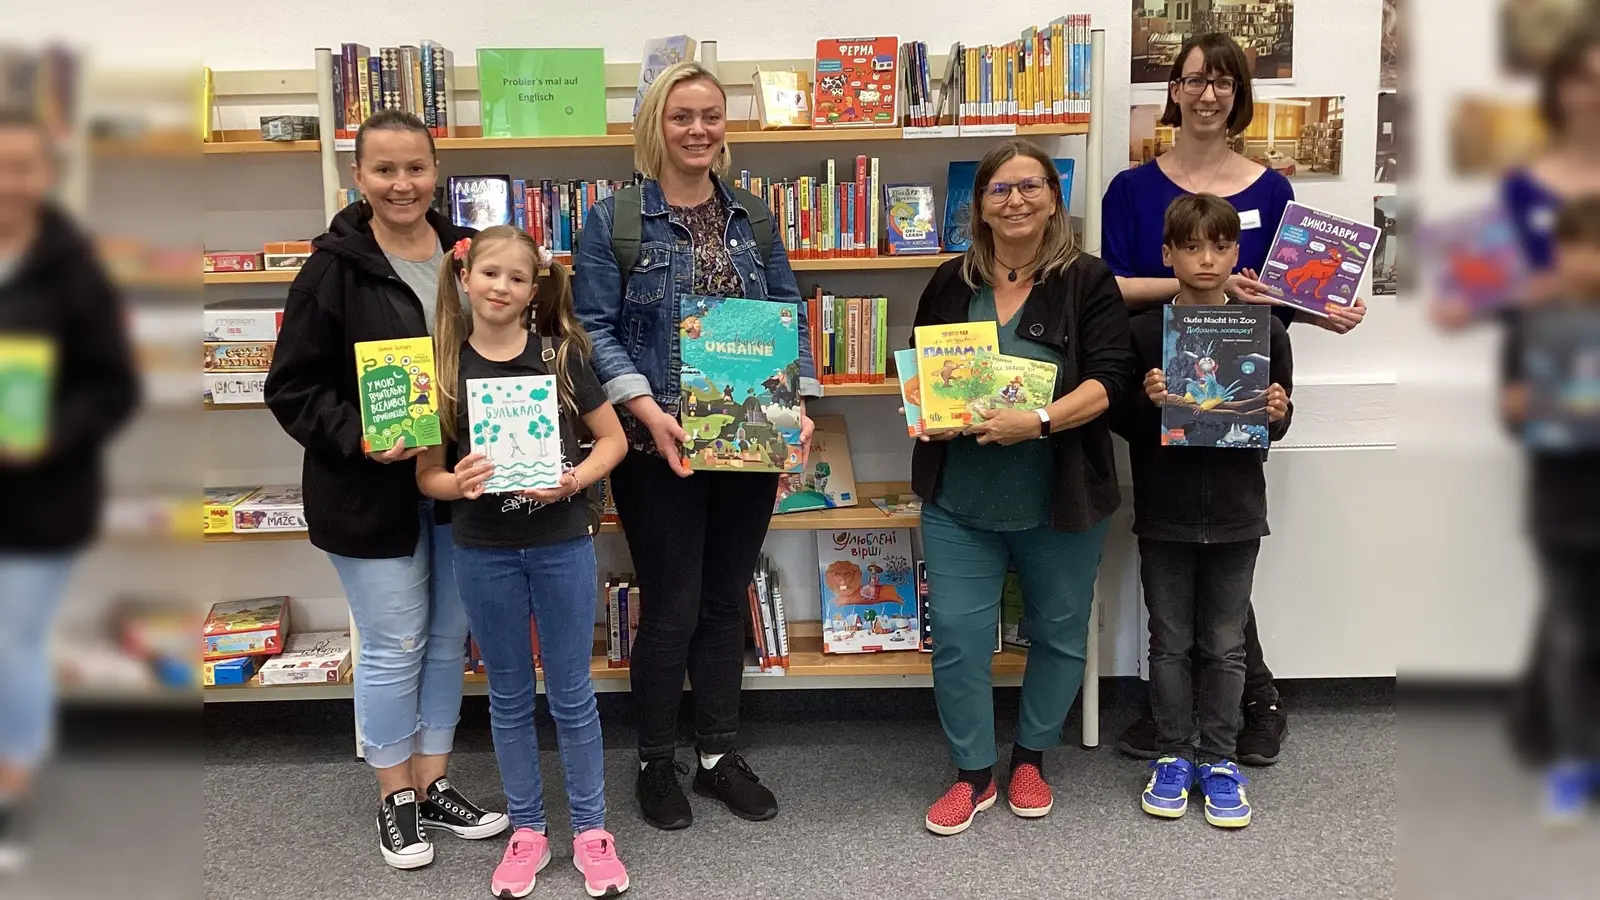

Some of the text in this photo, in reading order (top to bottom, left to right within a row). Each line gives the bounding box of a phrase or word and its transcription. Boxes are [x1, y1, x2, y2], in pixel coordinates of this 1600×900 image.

[838, 45, 874, 57] ФЕРМА
[503, 76, 579, 86] Probier's mal auf
[424, 88, 433, 108] KING
[518, 93, 554, 103] Englisch
[1299, 215, 1359, 242] ДИНОЗАВРИ
[215, 316, 256, 328] mission
[1183, 316, 1202, 324] Gute
[1203, 316, 1227, 324] Nacht
[704, 340, 774, 357] UKRAINE
[218, 358, 273, 367] EXPRES
[214, 380, 265, 395] PICTURE
[366, 377, 396, 393] У МОЮ
[368, 384, 407, 404] ВЧИТЕЛЬКУ
[370, 395, 407, 414] ВСЕЛИВСЯ
[485, 404, 542, 419] БУЛЬКАЛО
[210, 509, 229, 518] HABA
[267, 515, 297, 526] MAZE
